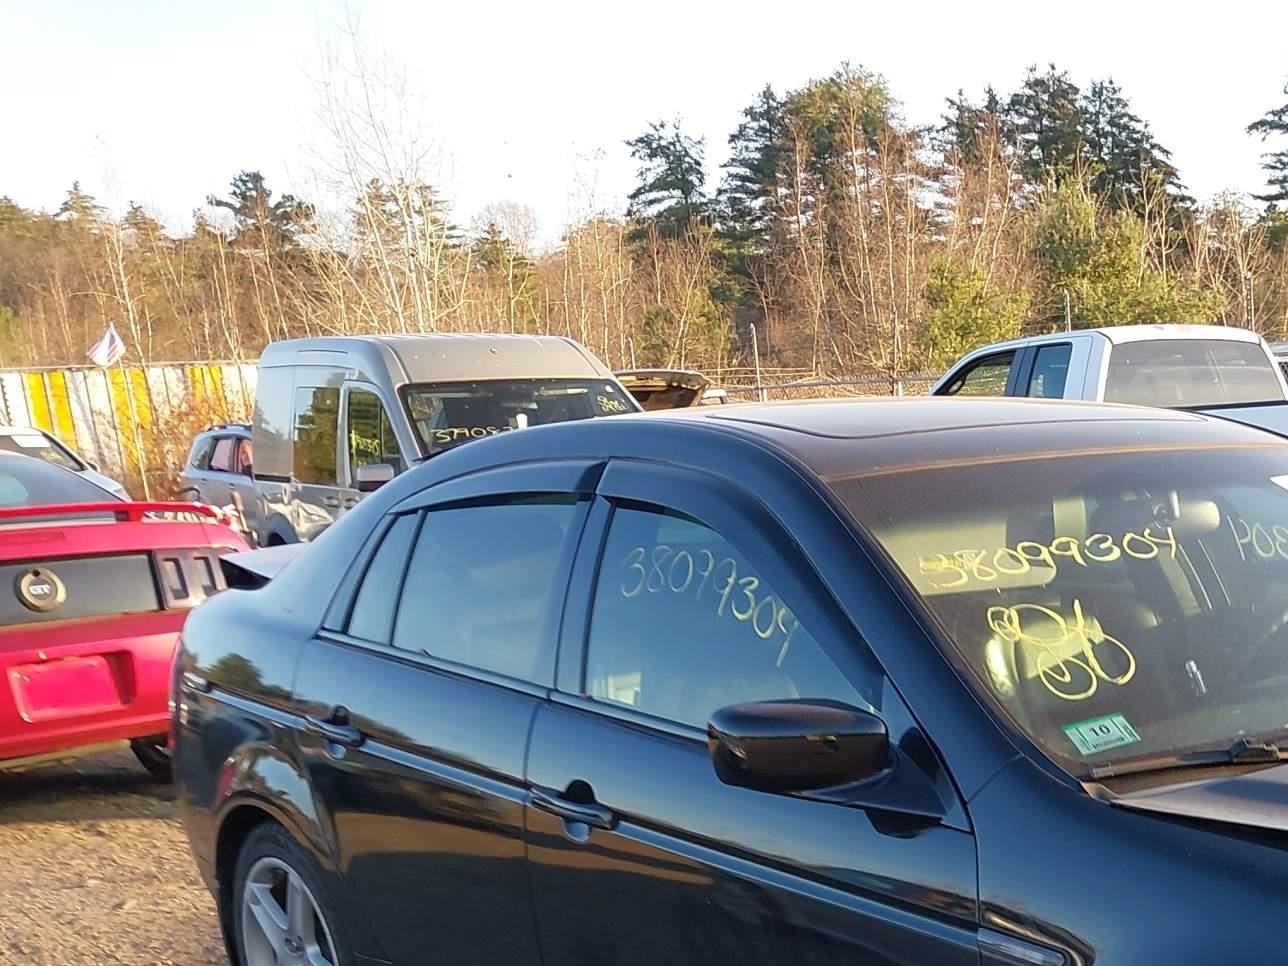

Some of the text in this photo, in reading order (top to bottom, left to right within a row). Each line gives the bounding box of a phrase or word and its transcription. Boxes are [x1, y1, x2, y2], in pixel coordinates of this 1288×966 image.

[920, 527, 1176, 588] 38099304
[29, 584, 51, 596] GT
[1089, 724, 1111, 737] 10
